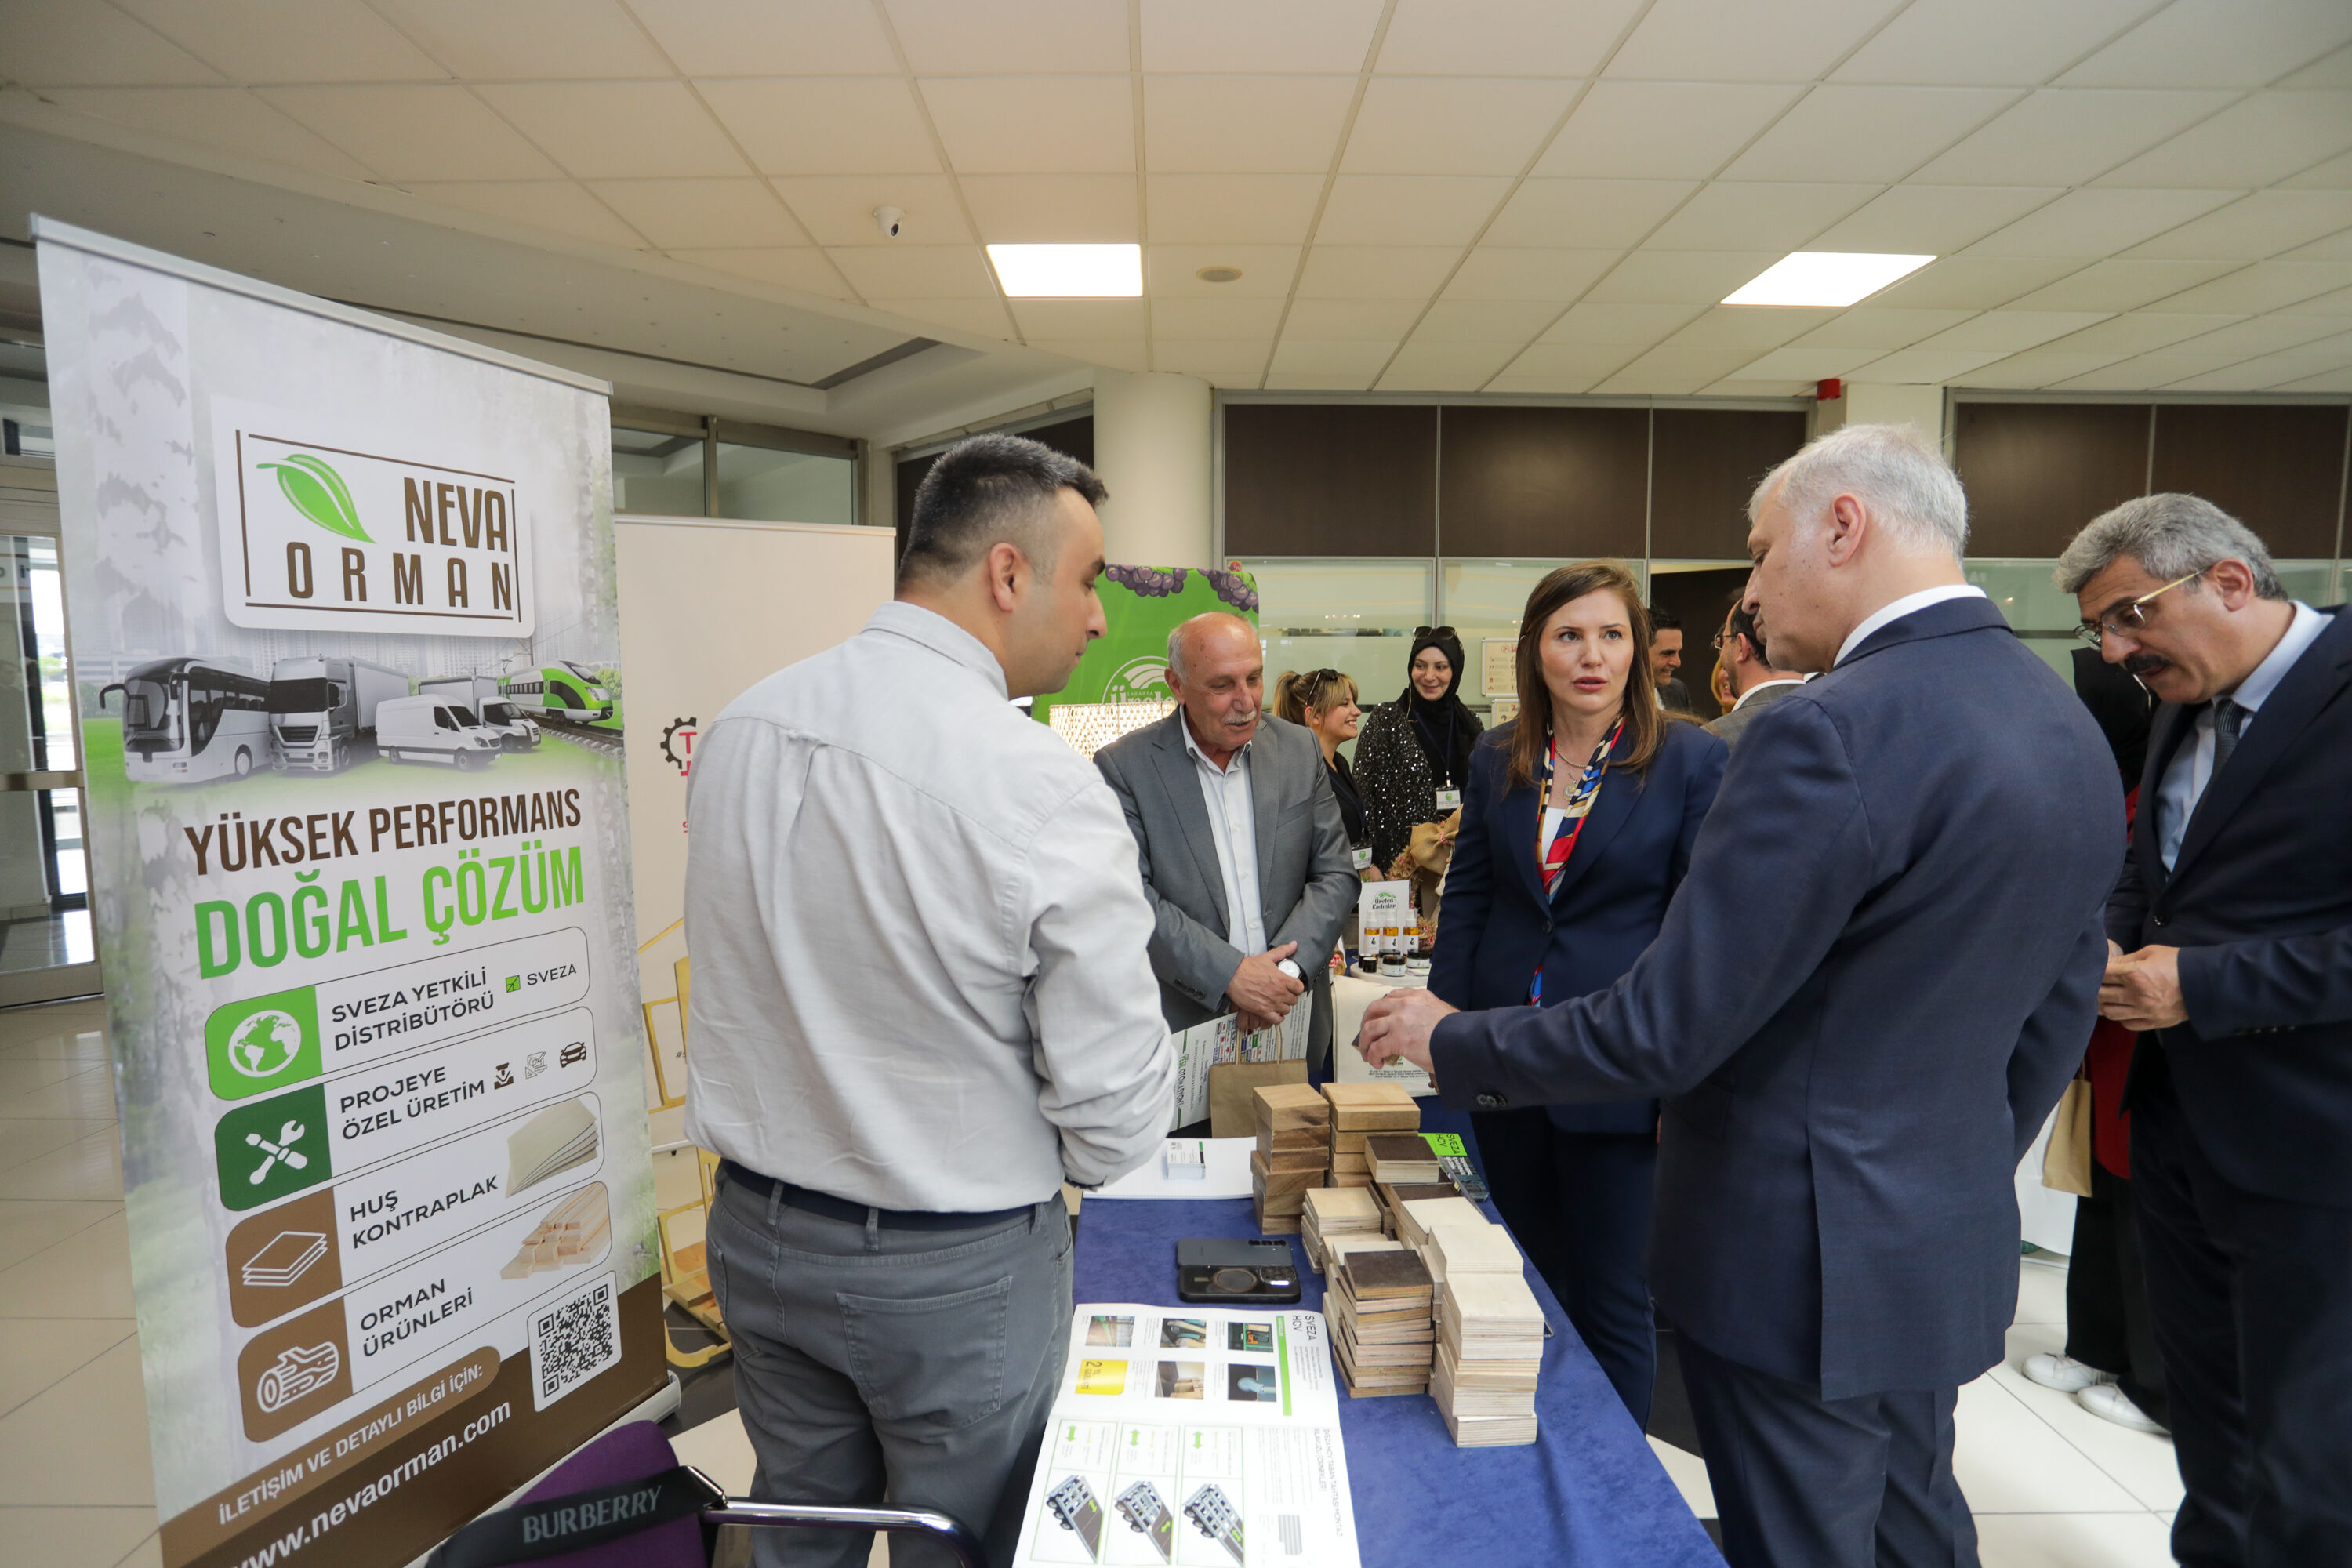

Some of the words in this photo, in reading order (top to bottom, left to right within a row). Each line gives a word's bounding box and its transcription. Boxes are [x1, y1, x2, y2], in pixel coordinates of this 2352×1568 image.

[405, 477, 508, 552] NEVA
[287, 540, 513, 612] ORMAN
[183, 810, 358, 876] YÜKSEK
[368, 788, 582, 853] PERFORMANS
[194, 868, 408, 980] DOĞAL
[422, 840, 584, 946] ÇÖZÜM
[331, 992, 409, 1023] SVEZA
[412, 967, 488, 1004] YETKİLİ
[526, 963, 577, 987] SVEZA
[334, 993, 495, 1051] DİSTRİBÜTÖRÜ
[339, 1066, 447, 1114] PROJEYE
[342, 1107, 402, 1142] ÖZEL
[407, 1080, 485, 1119] ÜRETİM
[1436, 1134, 1447, 1148] HCV
[1446, 1134, 1461, 1154] SVEZA
[349, 1189, 401, 1223] HUŞ
[352, 1175, 499, 1250] KONTRAPLAK
[360, 1278, 446, 1332] ORMAN
[362, 1287, 474, 1358] ÜRÜNLERİ
[1292, 1315, 1303, 1331] HCV
[1305, 1315, 1317, 1341] SVEZA
[219, 1463, 304, 1526] İLETİŞİM
[307, 1447, 332, 1473] VE
[336, 1407, 403, 1458] DETAYLI
[405, 1379, 446, 1416] BİLGİ
[448, 1362, 484, 1396] İÇİN:
[232, 1401, 511, 1568] ww.nevaorman.com
[522, 1485, 662, 1544] BURBERRY
